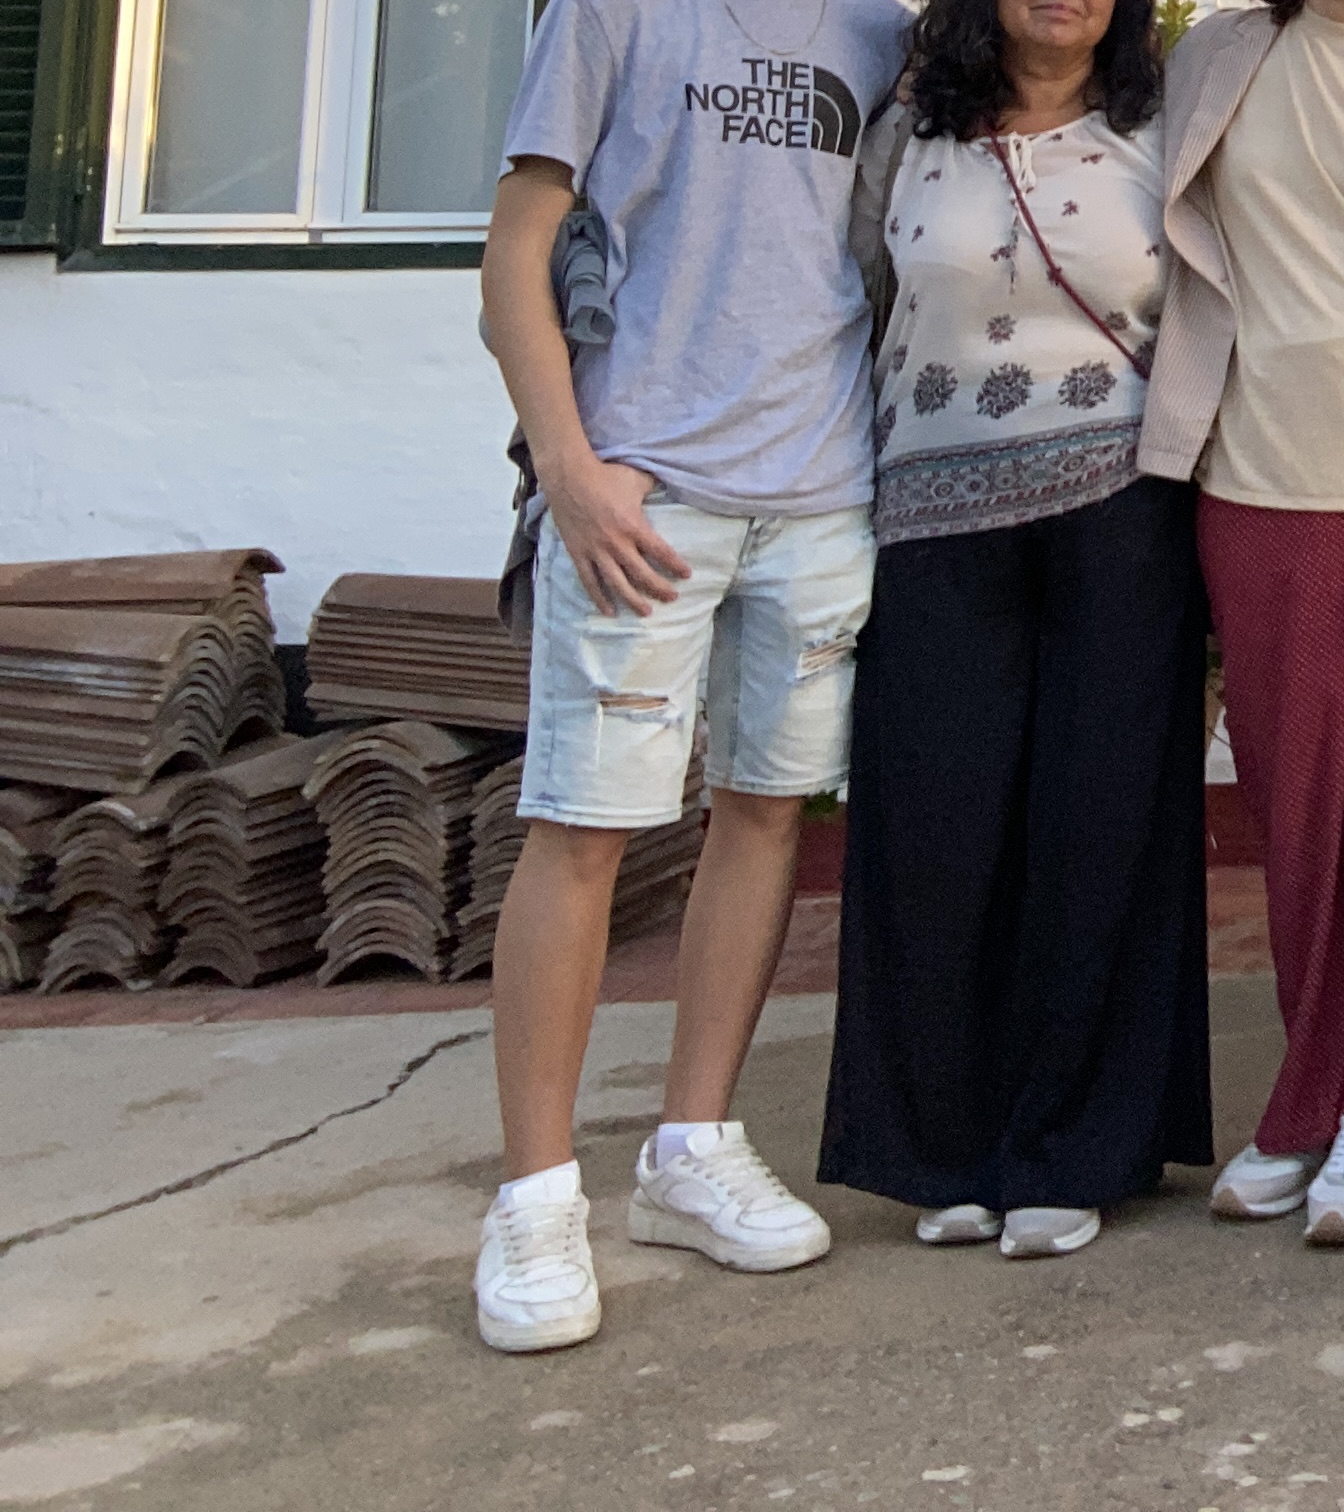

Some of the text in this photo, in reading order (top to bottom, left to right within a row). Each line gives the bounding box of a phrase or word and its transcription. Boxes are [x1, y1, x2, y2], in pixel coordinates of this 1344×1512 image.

[742, 58, 810, 89] THE
[684, 83, 810, 118] NORTH
[722, 114, 808, 148] FACE
